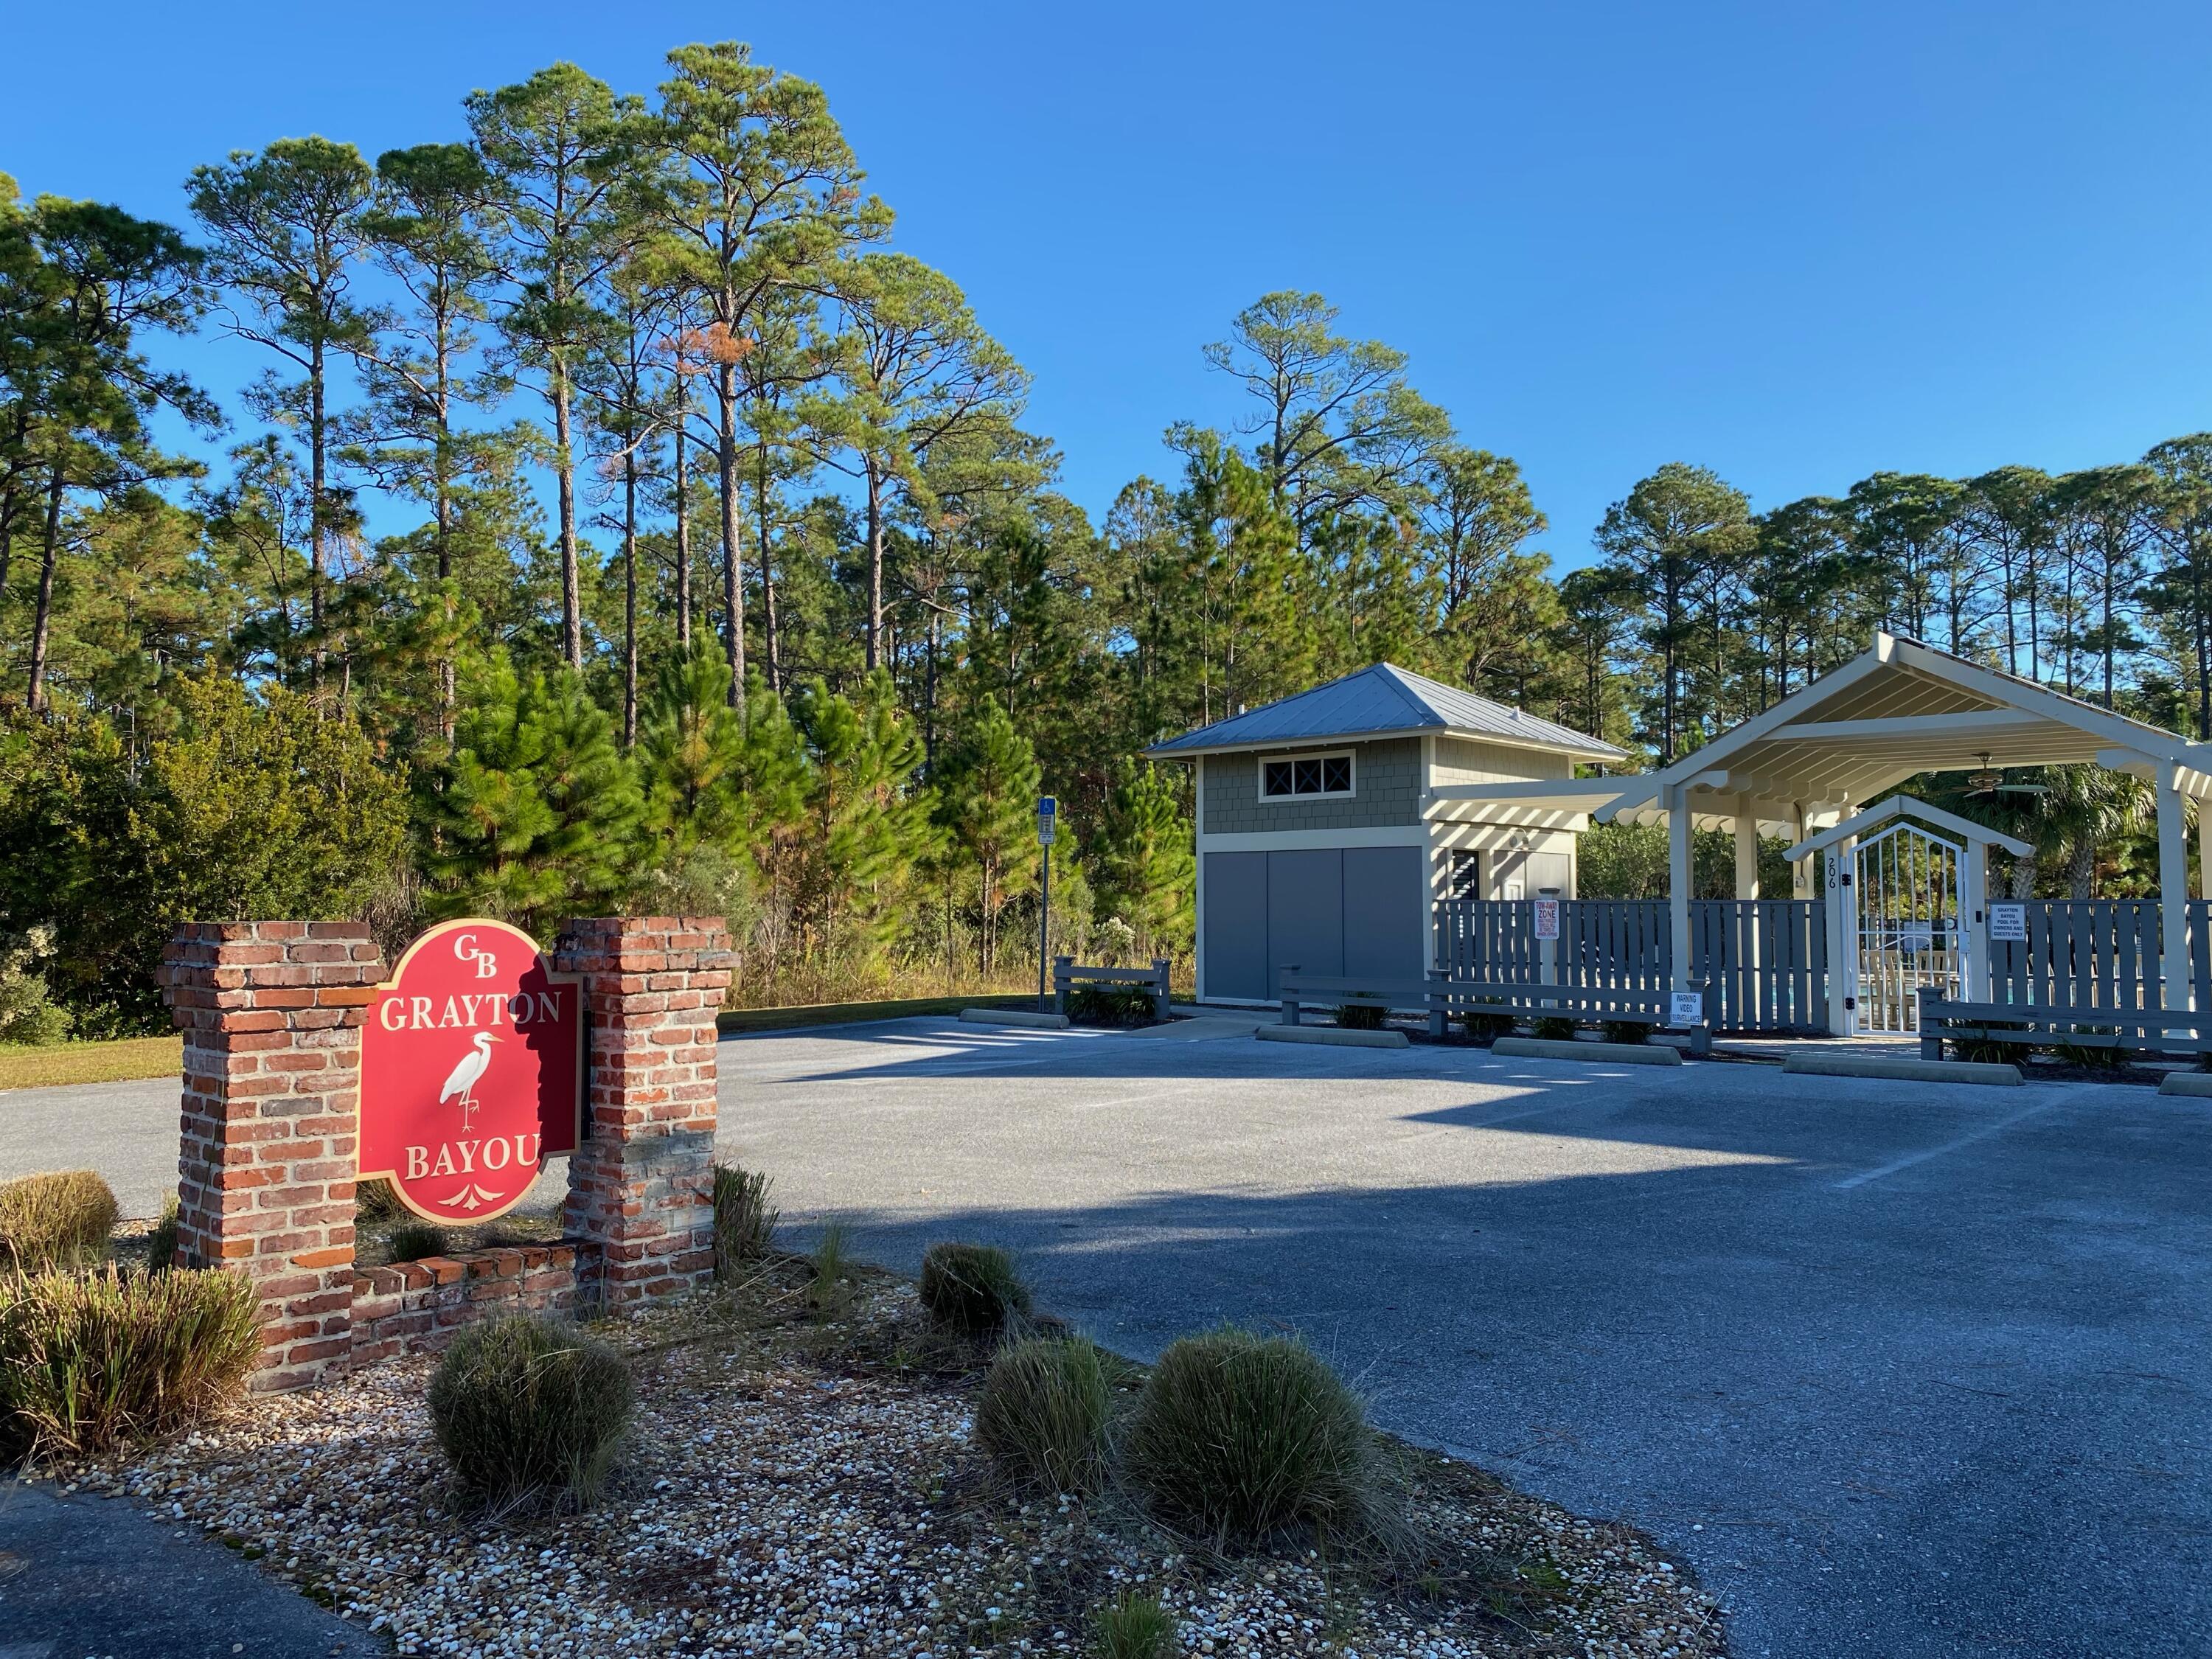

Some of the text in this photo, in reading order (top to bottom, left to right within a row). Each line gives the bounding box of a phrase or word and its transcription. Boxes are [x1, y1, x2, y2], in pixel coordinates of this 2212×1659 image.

[1536, 901, 1558, 910] TOW-AWAY
[1538, 910, 1556, 919] ZONE
[1676, 994, 1697, 1004] WARNING
[380, 991, 562, 1032] GRAYTON
[1680, 1004, 1693, 1013] VIDEO
[1672, 1014, 1700, 1023] SURVEILLANCE
[404, 1133, 542, 1180] BAYOU
